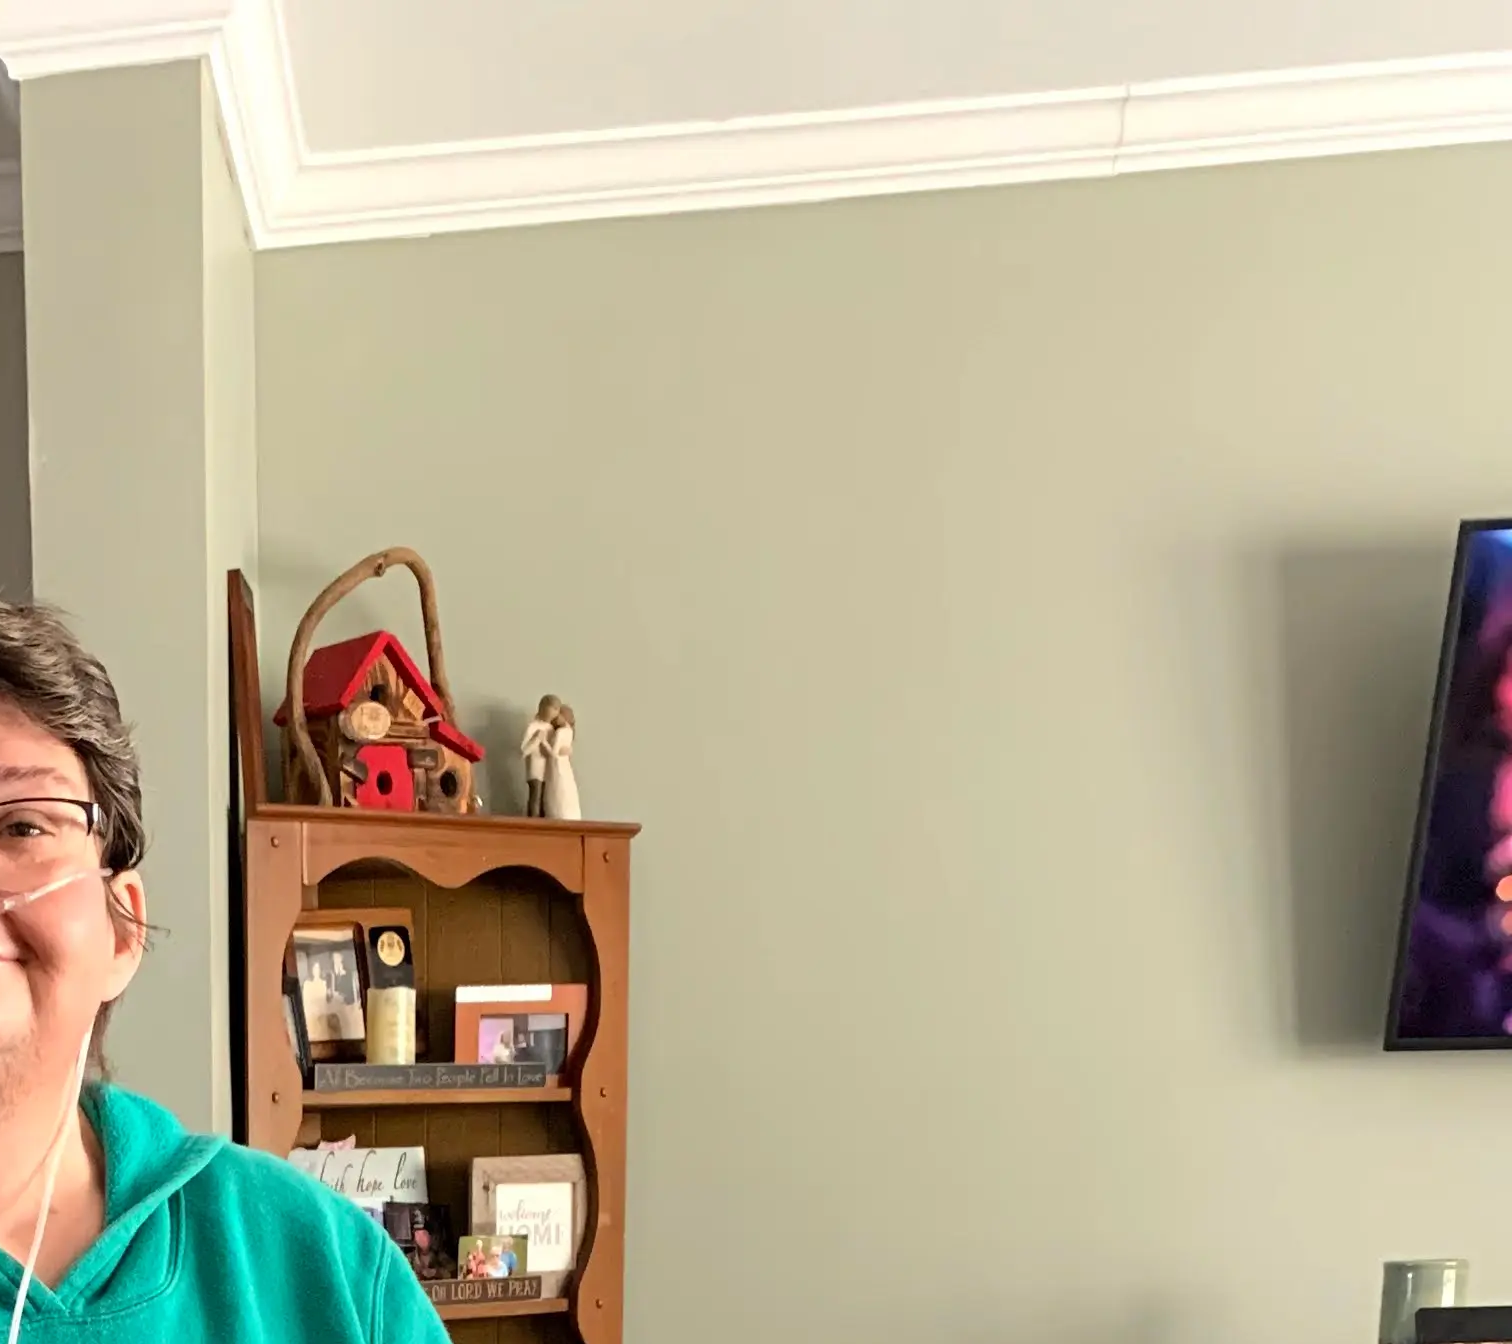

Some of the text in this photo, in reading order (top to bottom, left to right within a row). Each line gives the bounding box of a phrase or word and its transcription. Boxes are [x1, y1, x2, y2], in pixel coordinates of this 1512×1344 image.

[356, 1148, 384, 1194] hope
[451, 1282, 483, 1300] LORD
[487, 1280, 504, 1298] WE
[508, 1279, 538, 1298] PRAY
